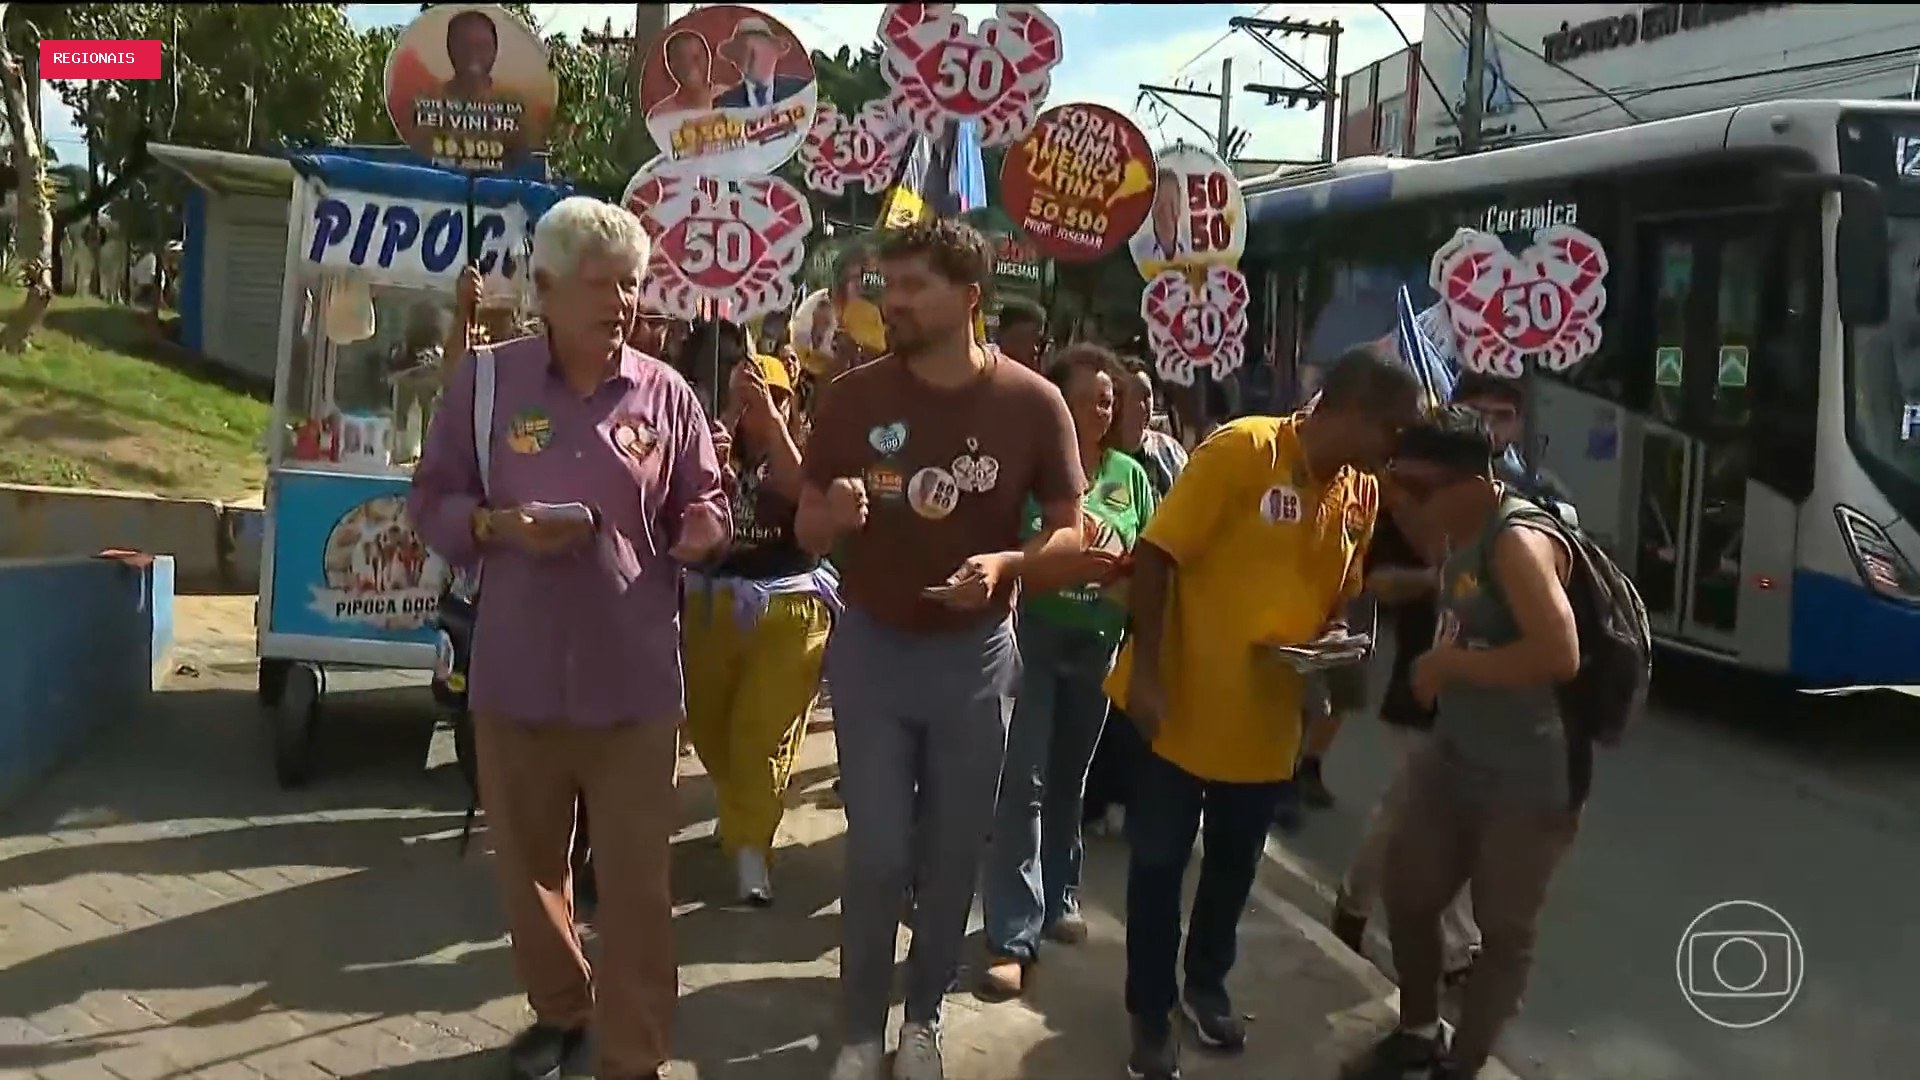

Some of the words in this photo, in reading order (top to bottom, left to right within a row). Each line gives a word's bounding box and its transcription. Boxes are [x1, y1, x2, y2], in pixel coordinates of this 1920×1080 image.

[932, 45, 1004, 101] 50
[417, 111, 444, 128] LEI
[450, 113, 488, 132] VINI
[1058, 107, 1116, 144] FORA
[833, 131, 877, 167] 50
[1026, 157, 1105, 202] LATINA
[1187, 171, 1229, 211] 50
[309, 199, 532, 280] PIPOC
[680, 221, 751, 274] 50
[1190, 212, 1232, 252] 50
[1182, 305, 1222, 347] 50
[1502, 280, 1562, 339] 50
[336, 598, 396, 617] PIPOCA
